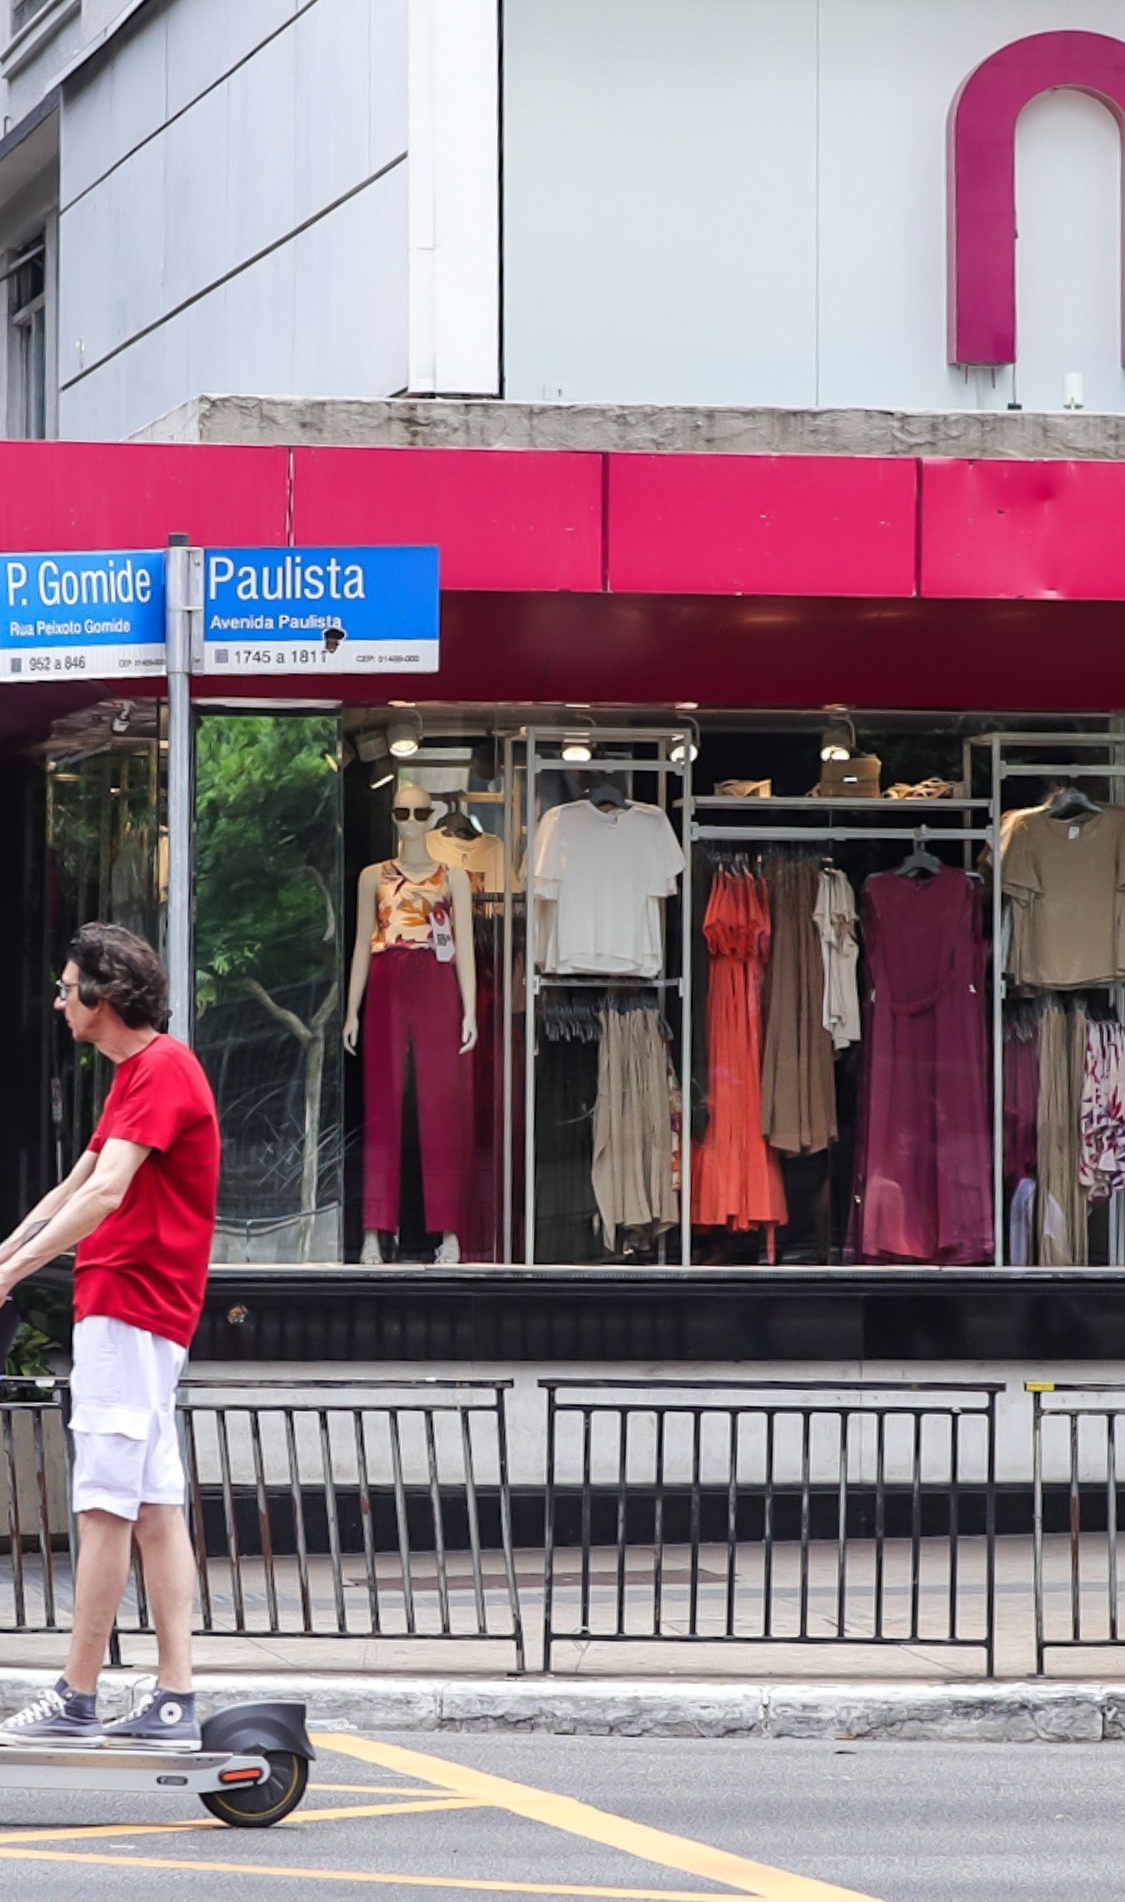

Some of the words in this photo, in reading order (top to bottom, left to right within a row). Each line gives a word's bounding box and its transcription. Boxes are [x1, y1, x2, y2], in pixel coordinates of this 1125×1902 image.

[6, 562, 28, 606] P.
[38, 559, 151, 606] Gomide
[208, 556, 366, 600] Paulista
[10, 621, 35, 636] Rua
[36, 619, 82, 636] Peixoto
[84, 618, 131, 634] Gomide
[210, 614, 274, 630] Avenida
[278, 614, 342, 630] Paulista
[54, 659, 62, 670] a
[234, 650, 271, 664] 1745
[275, 652, 286, 664] a
